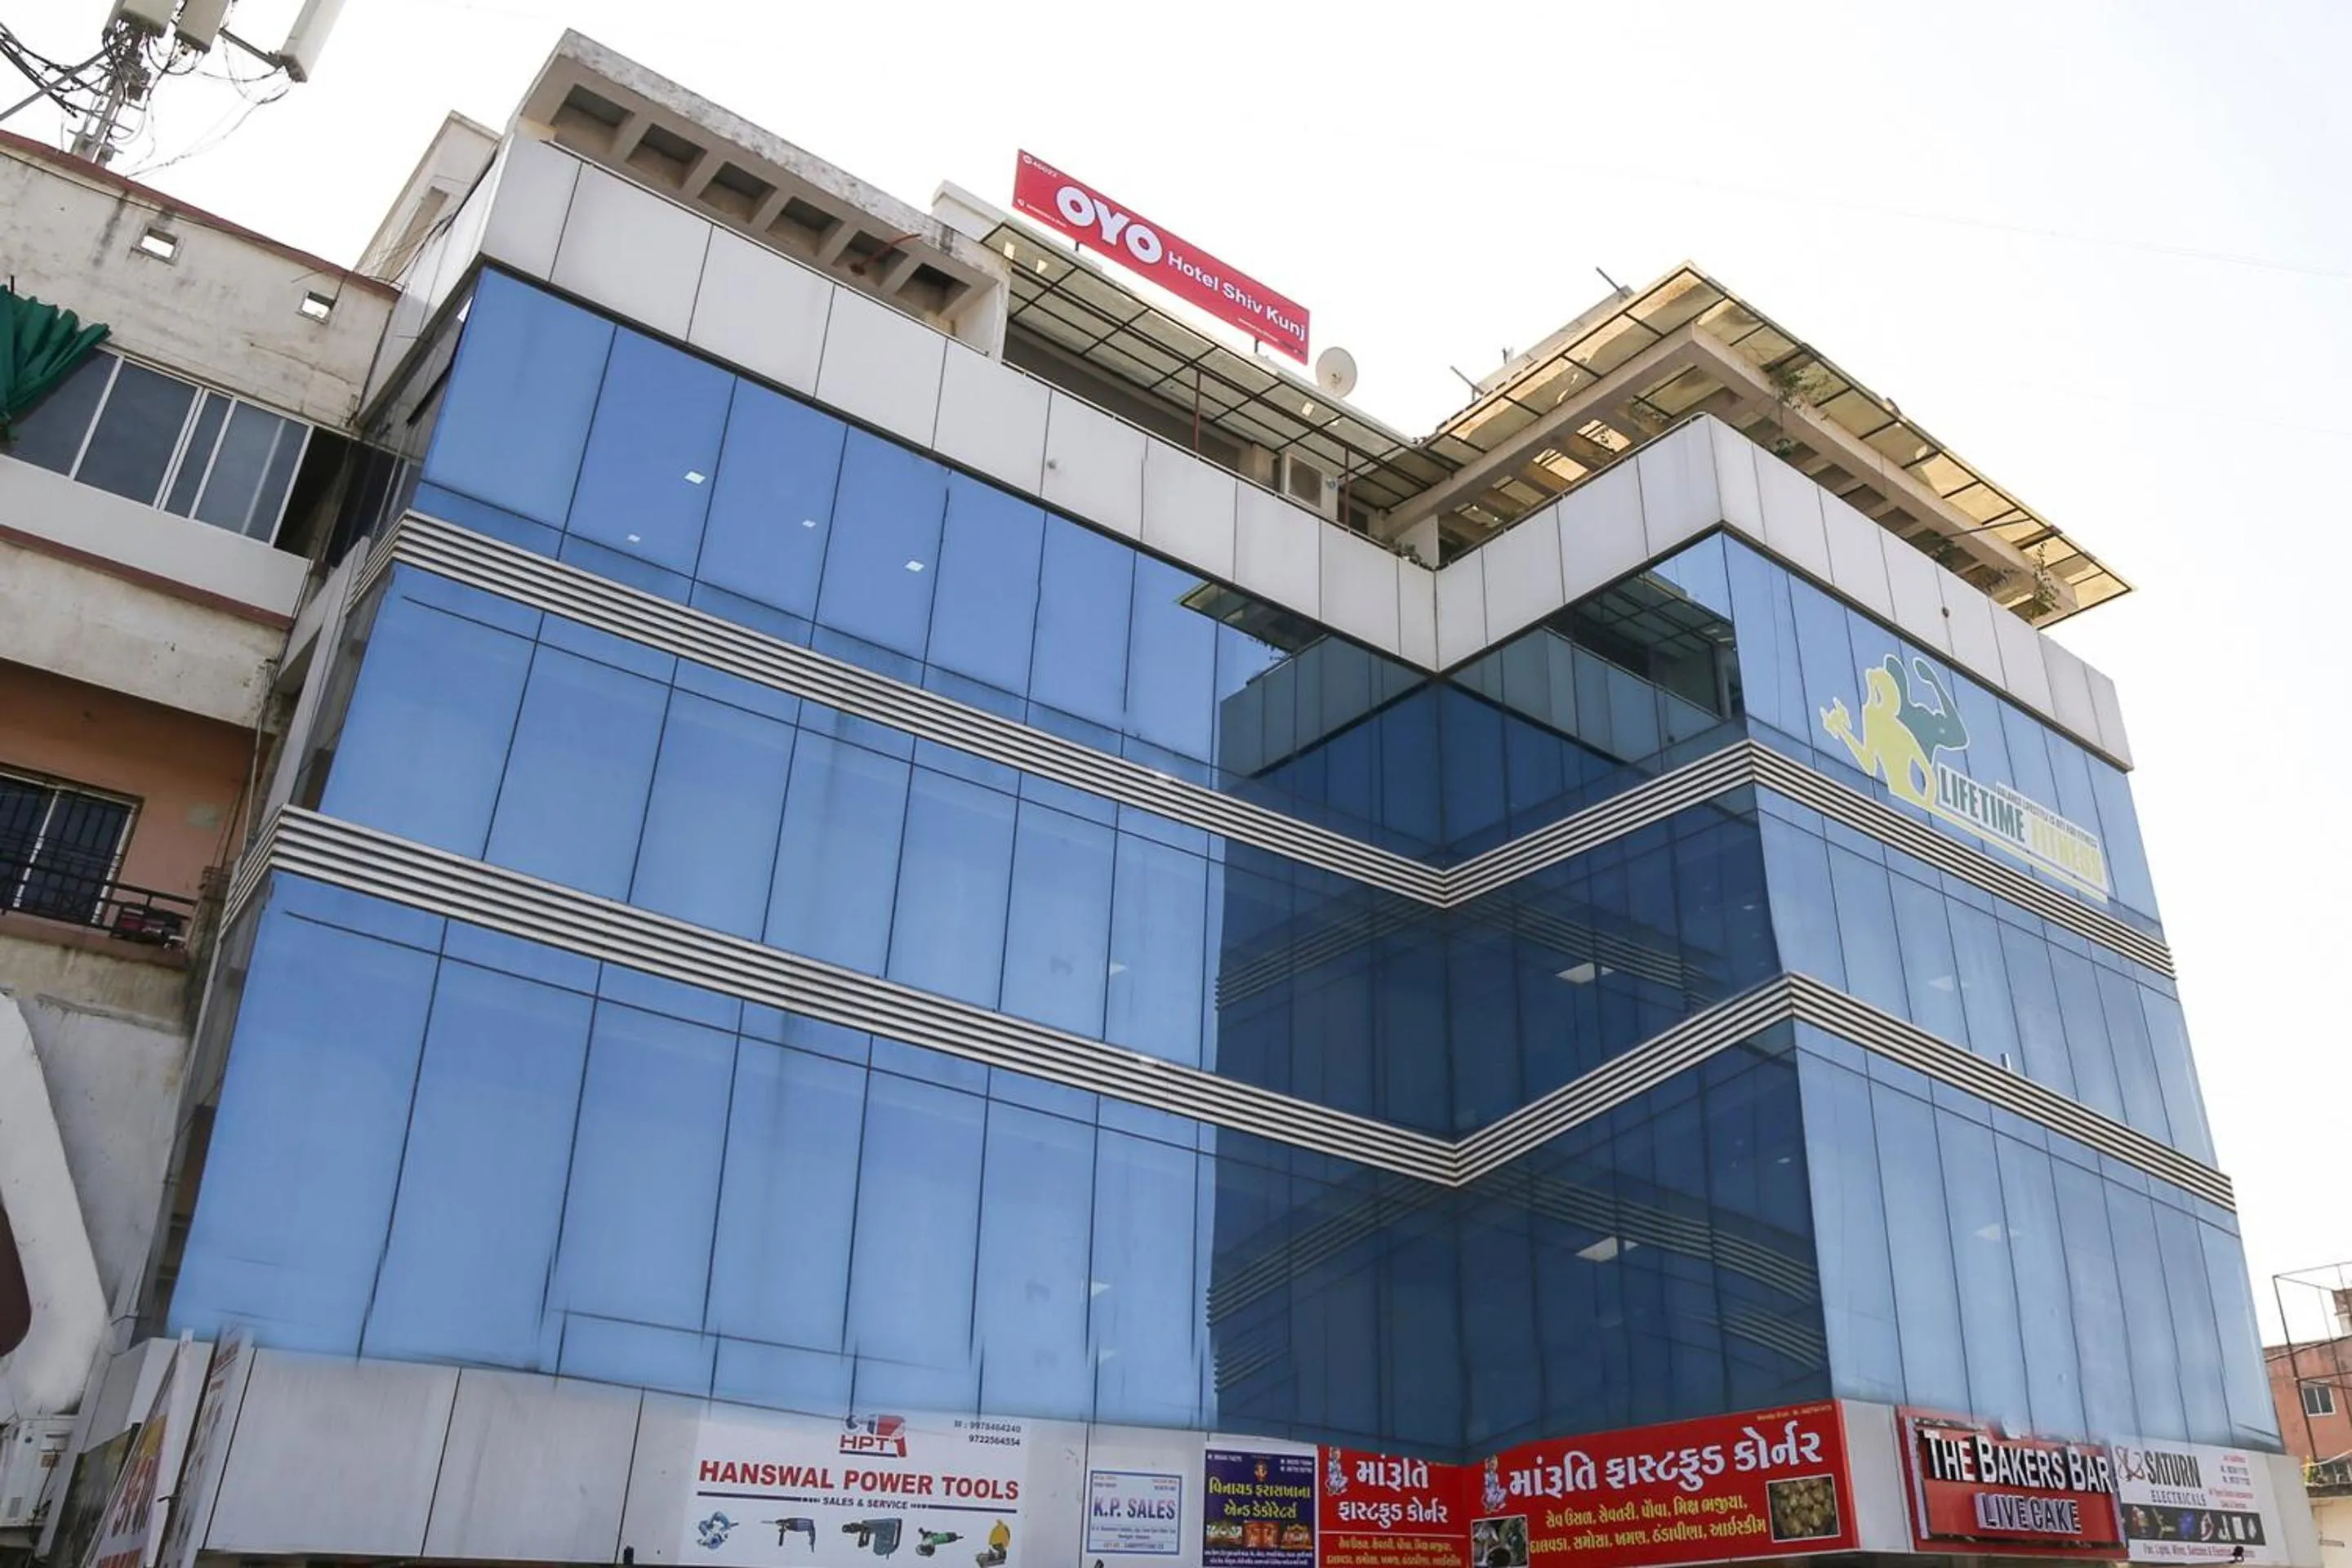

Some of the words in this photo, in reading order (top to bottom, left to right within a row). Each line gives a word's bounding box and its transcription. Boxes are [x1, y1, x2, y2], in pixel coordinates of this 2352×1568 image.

[1056, 185, 1163, 265] OYO
[1168, 250, 1219, 292] Hotel
[1223, 281, 1263, 314] Shiv
[1266, 305, 1306, 341] Kunj
[1940, 766, 2025, 844] LIFETIME
[840, 1433, 890, 1451] HPT
[1733, 1419, 1824, 1472] કોર્નર
[1923, 1428, 1976, 1482] THE
[1975, 1433, 2067, 1490] BAKERS
[2065, 1441, 2114, 1494] BAR
[698, 1459, 835, 1490] HANSWAL
[843, 1469, 934, 1496] POWER
[941, 1476, 1020, 1501] TOOLS
[2144, 1450, 2203, 1489] SATURN
[822, 1496, 854, 1507] SALES
[857, 1499, 864, 1508] &
[866, 1499, 909, 1510] SERVICE
[1094, 1496, 1122, 1517] K.P.
[1126, 1497, 1177, 1521] SALES
[1406, 1495, 1449, 1524] કોર્નર
[1980, 1493, 2029, 1530] LIVE
[2029, 1496, 2082, 1535] CAKE
[2150, 1489, 2207, 1507] ELECTRICALS
